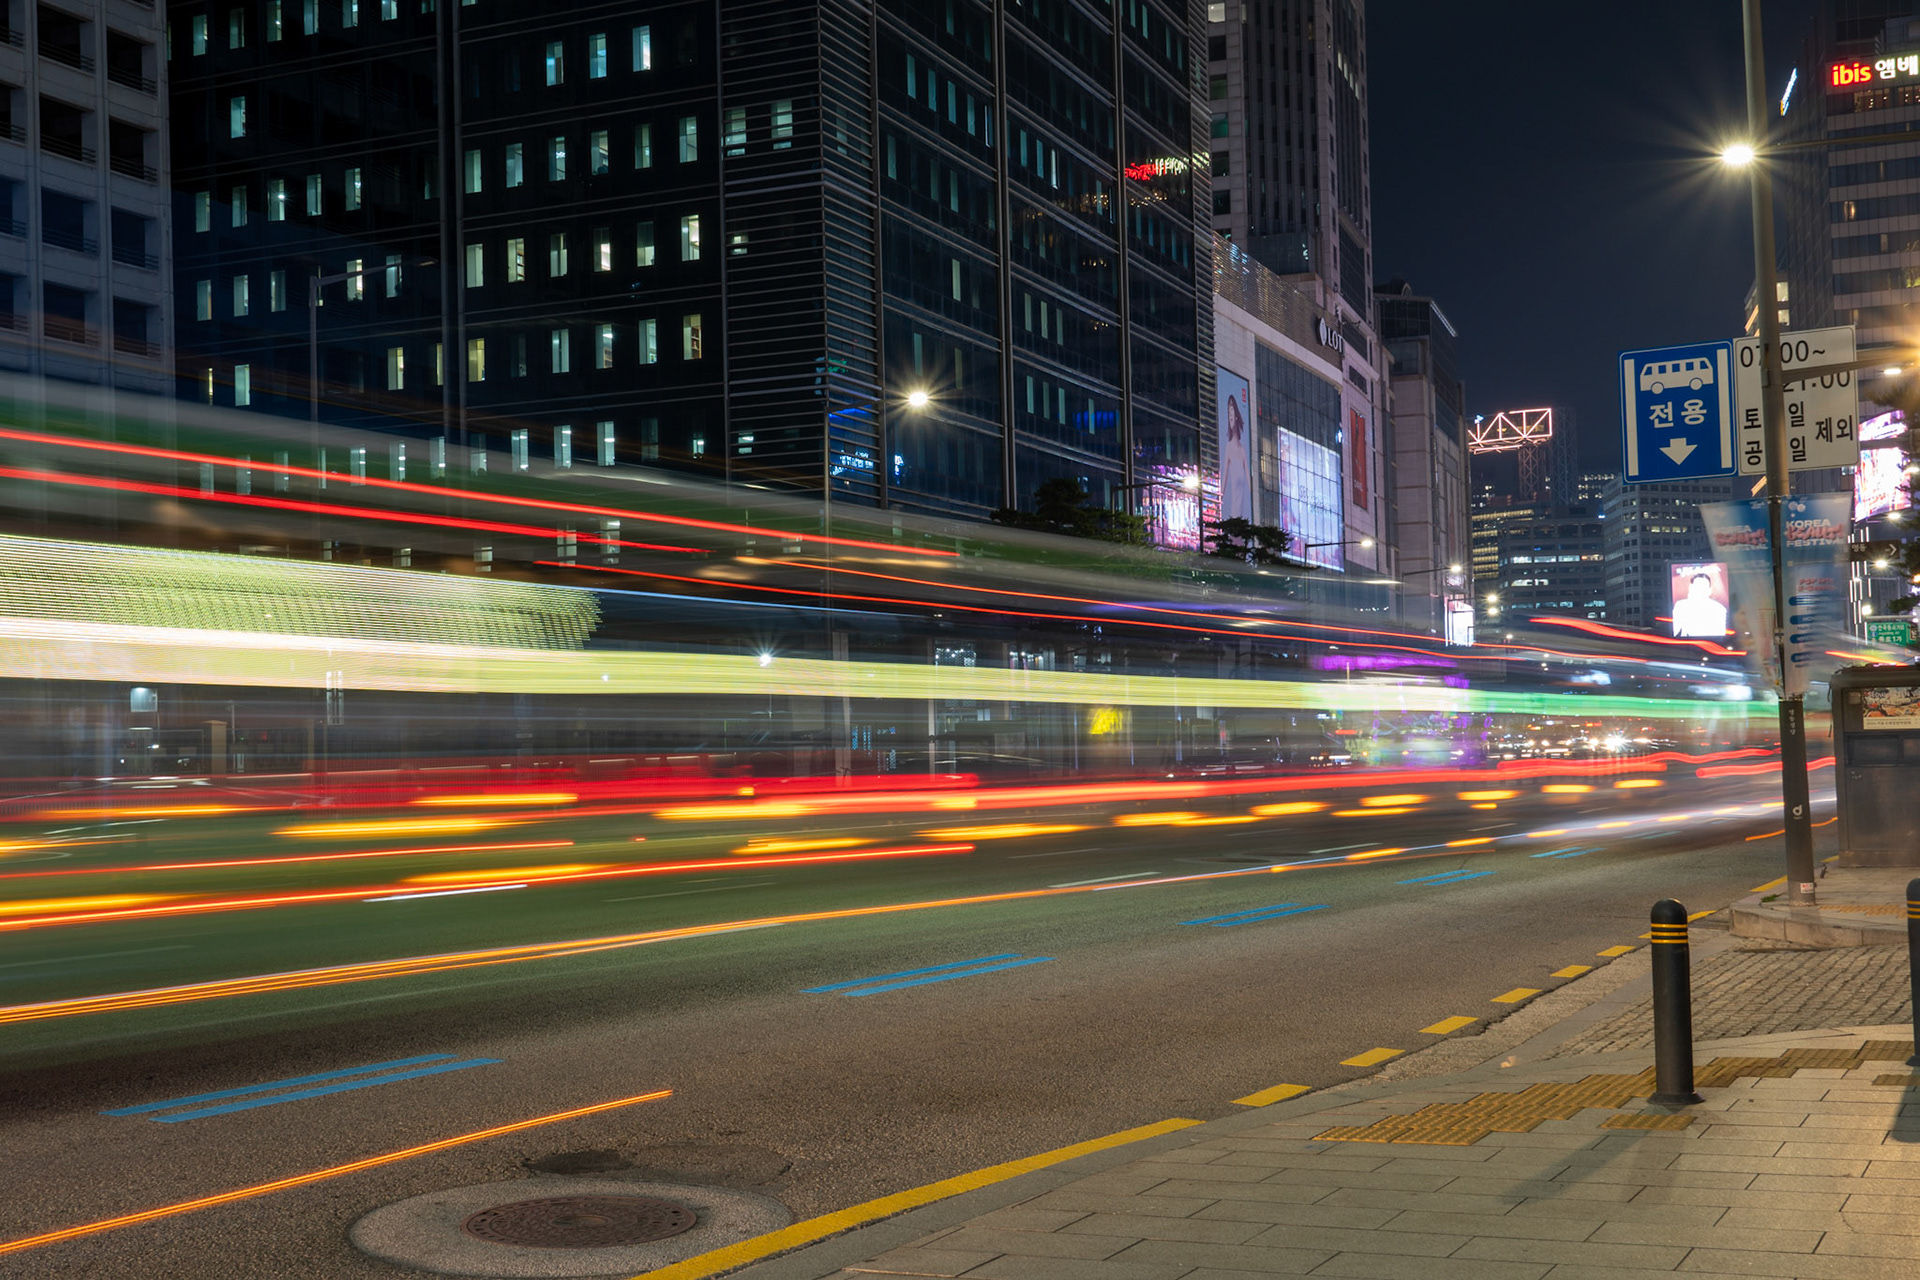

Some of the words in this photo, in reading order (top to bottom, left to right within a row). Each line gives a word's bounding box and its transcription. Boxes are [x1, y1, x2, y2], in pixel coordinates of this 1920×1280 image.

[1832, 62, 1872, 86] ibis
[1874, 54, 1919, 79] 앰배
[1815, 415, 1853, 443] 제외
[1786, 518, 1831, 529] KOREA
